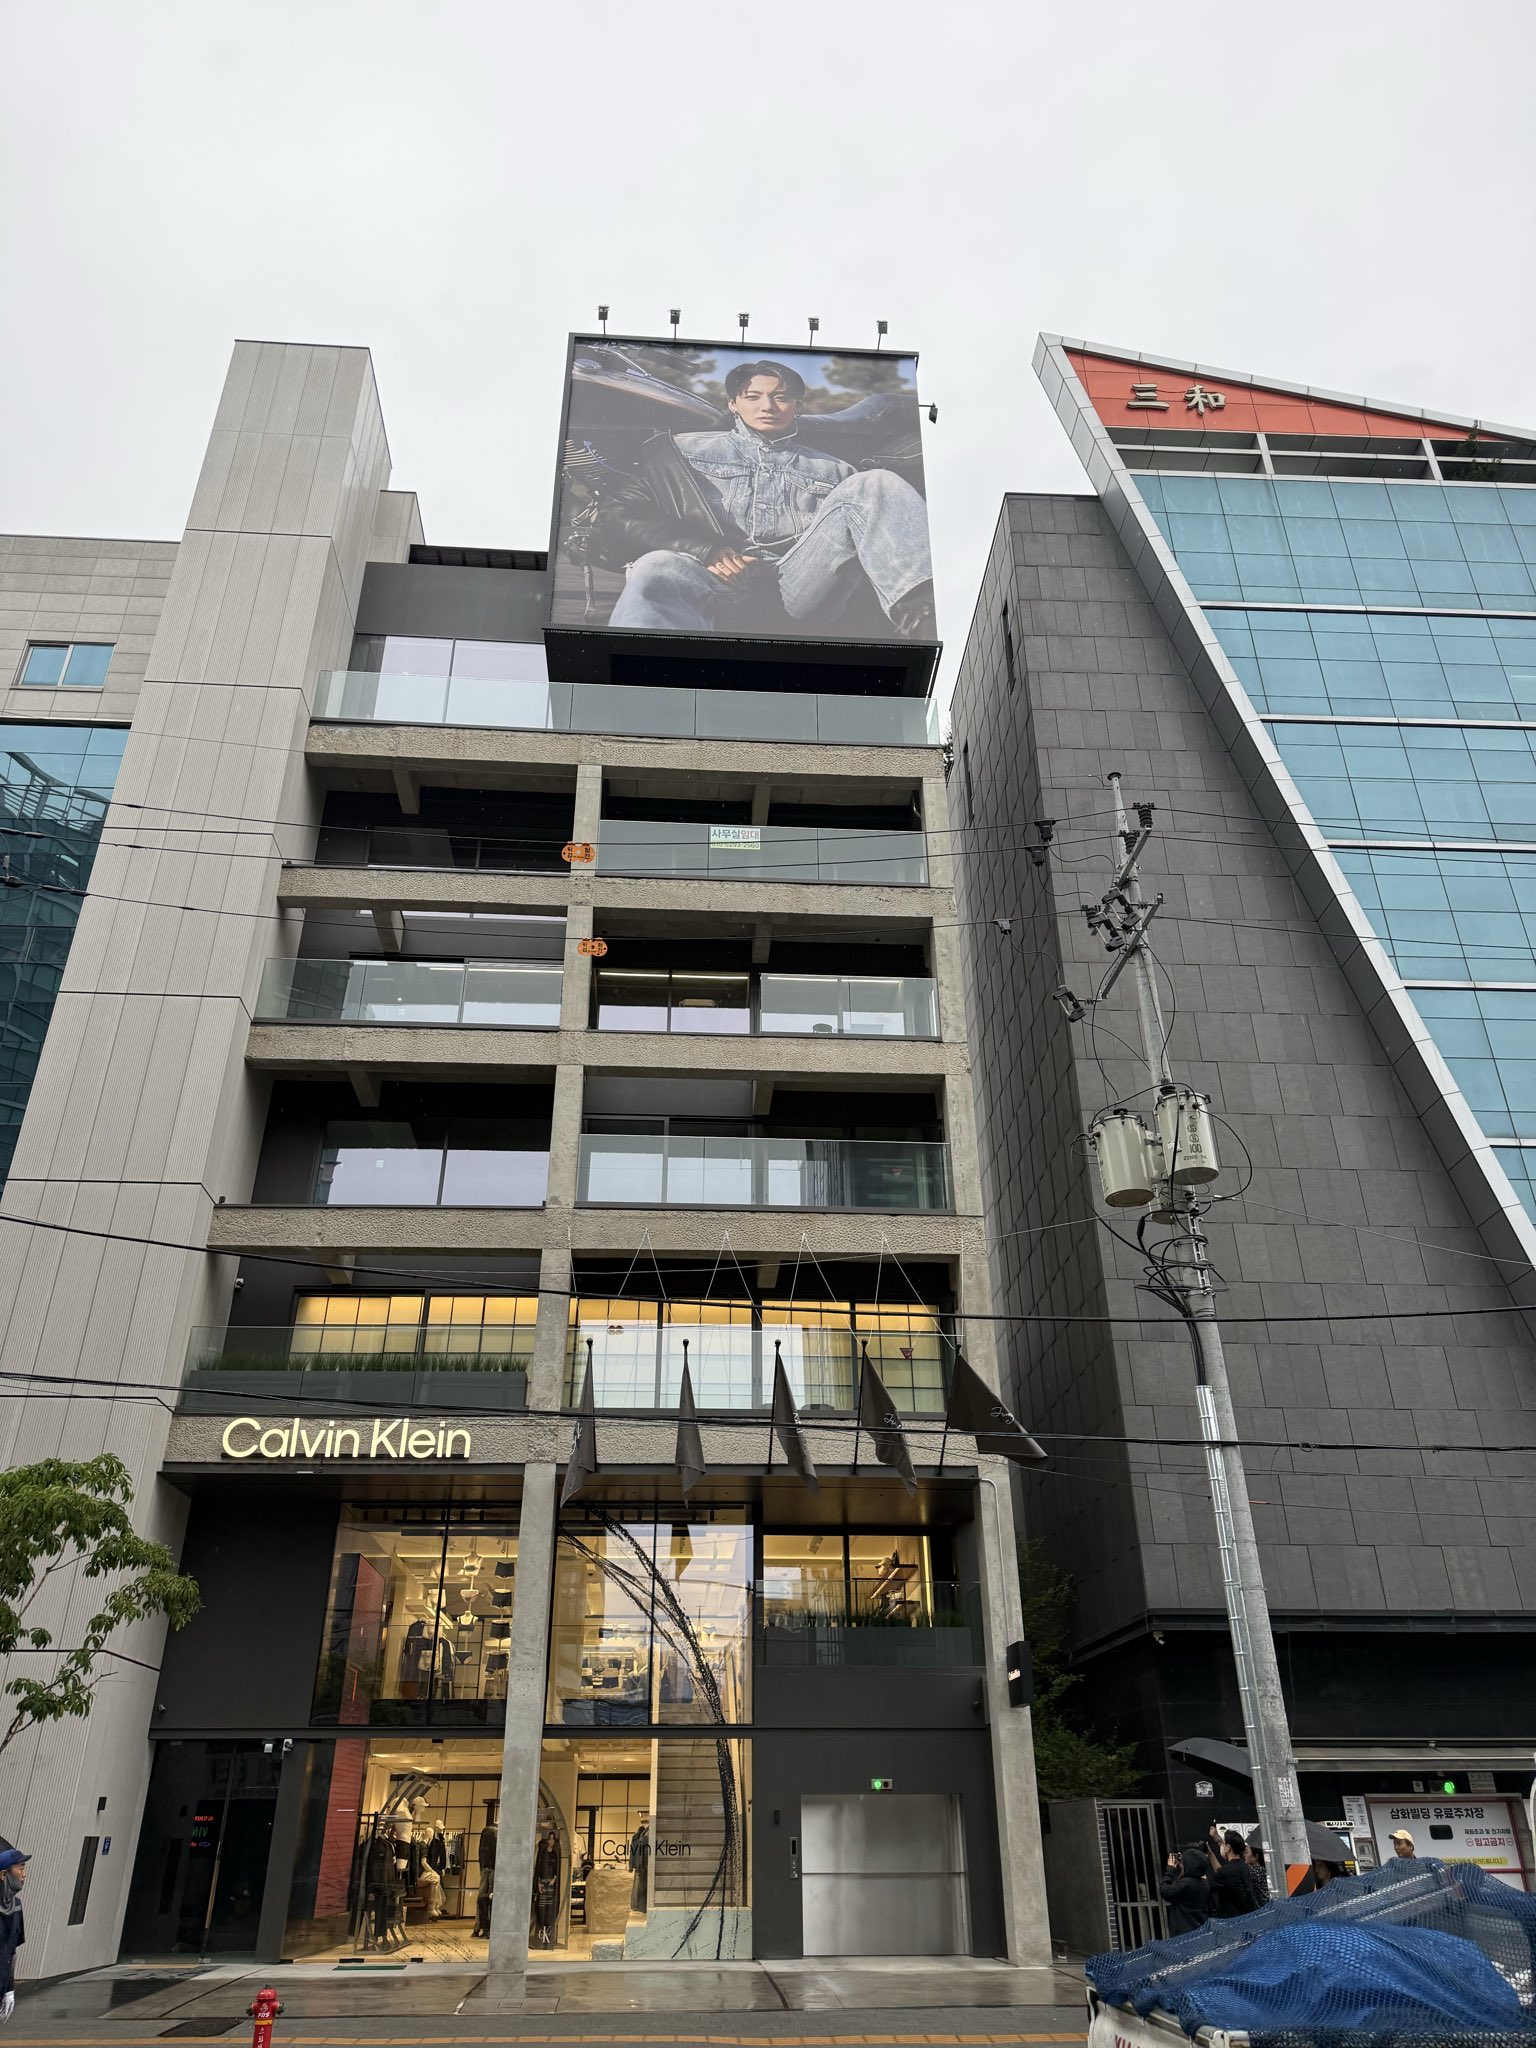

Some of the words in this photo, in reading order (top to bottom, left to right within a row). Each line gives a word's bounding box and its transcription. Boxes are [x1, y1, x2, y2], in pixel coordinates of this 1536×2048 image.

[1126, 383, 1226, 416] 三和
[712, 828, 760, 840] 사무실임대
[1189, 1143, 1203, 1154] 100
[222, 1417, 360, 1458] Calvin
[370, 1418, 471, 1458] Klein
[1390, 1807, 1431, 1820] 삼화빌딩
[1433, 1807, 1484, 1820] 유료주차장
[602, 1839, 651, 1856] Calvin
[655, 1840, 691, 1856] Klein
[1474, 1837, 1506, 1847] 입고금지
